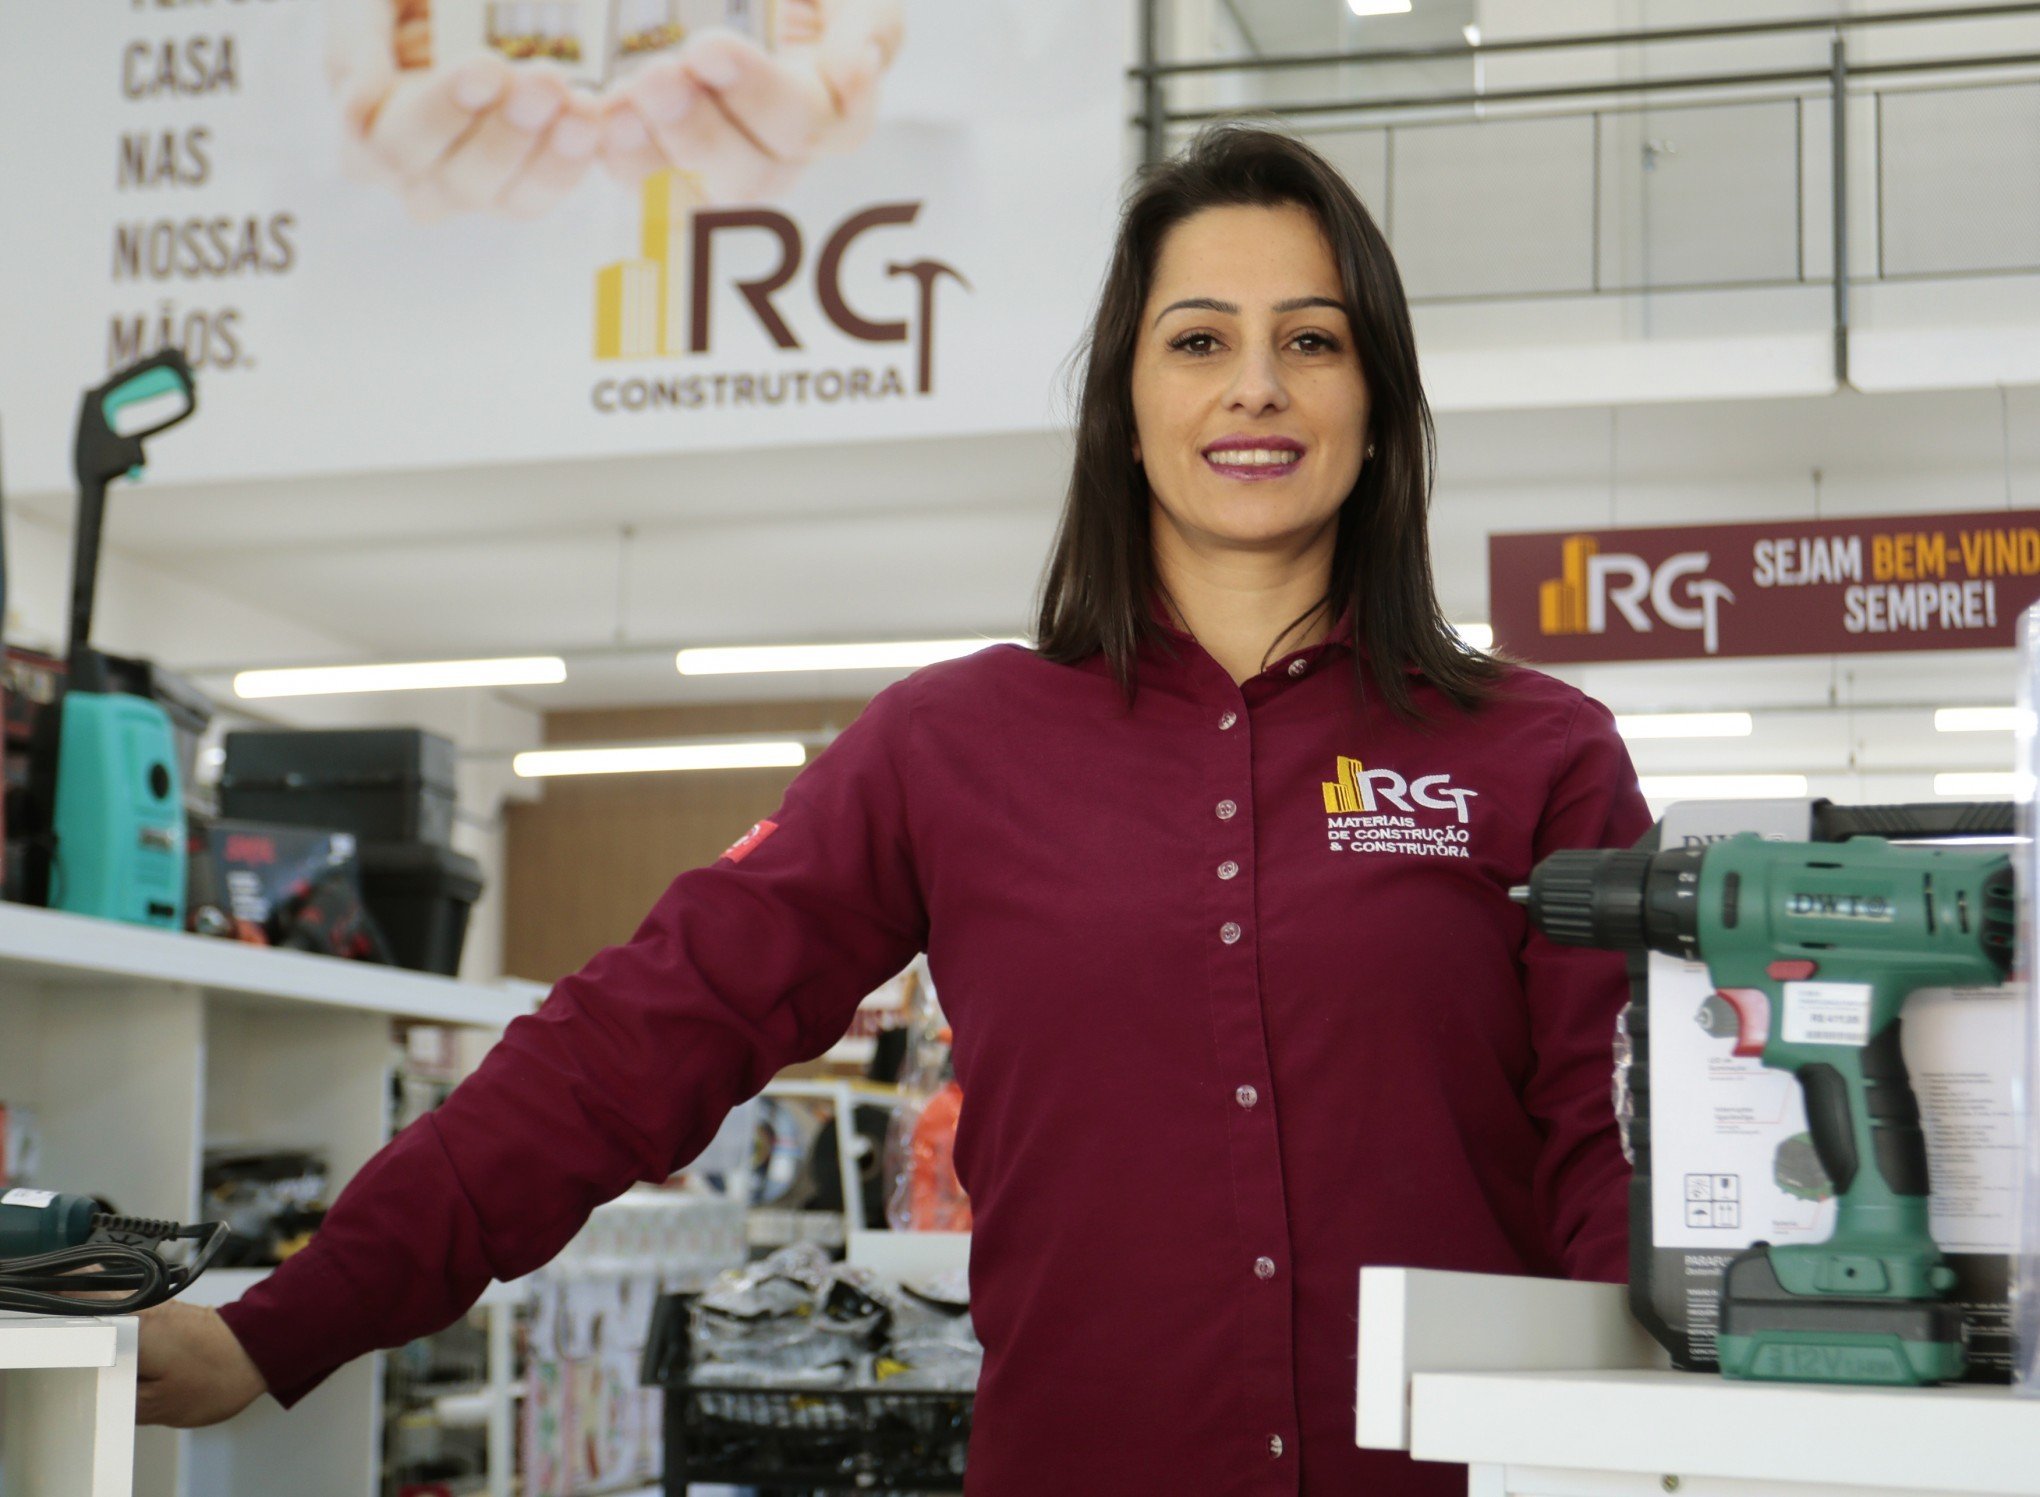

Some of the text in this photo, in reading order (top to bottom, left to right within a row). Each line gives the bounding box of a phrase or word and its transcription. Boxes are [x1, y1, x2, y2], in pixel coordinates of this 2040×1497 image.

[121, 35, 240, 101] CASA
[116, 124, 212, 190] NAS
[112, 211, 297, 282] NOSSAS
[690, 200, 974, 396] RG
[591, 365, 906, 414] CONSTRUTORA
[1752, 536, 1863, 588] SEJAM
[1586, 551, 1735, 655] RG
[1843, 580, 1997, 634] SEMPRE!
[1328, 815, 1415, 829] MATERIAIS
[1356, 769, 1479, 824] RG
[1328, 825, 1470, 846] DE CONSTRUÇÃO
[1330, 841, 1470, 858] & CONSTRUTORA
